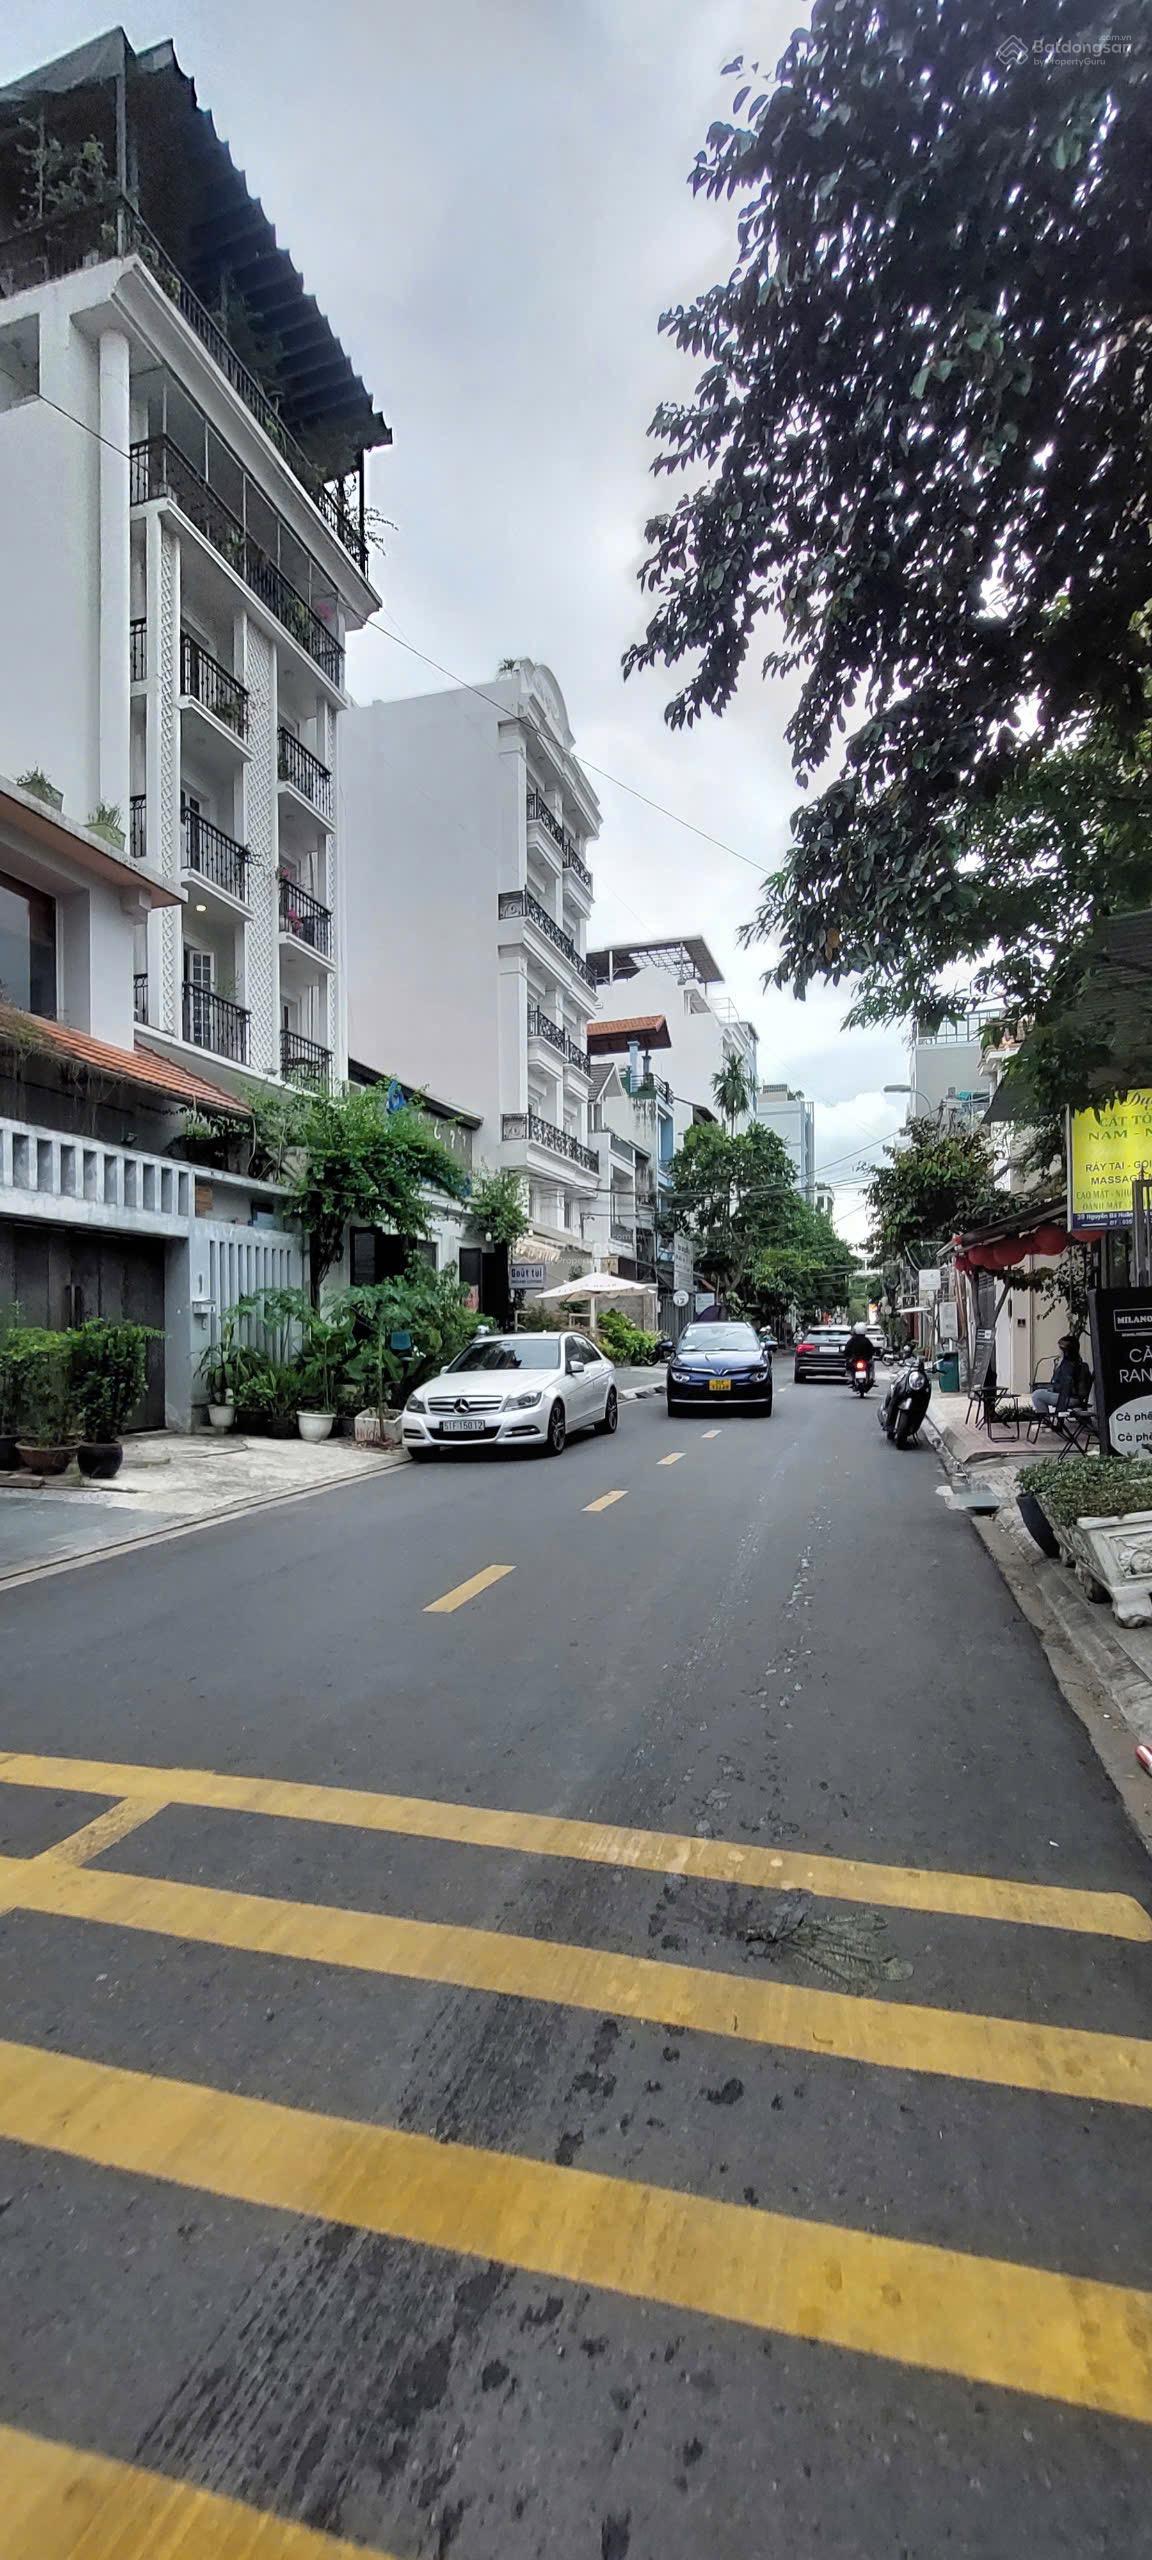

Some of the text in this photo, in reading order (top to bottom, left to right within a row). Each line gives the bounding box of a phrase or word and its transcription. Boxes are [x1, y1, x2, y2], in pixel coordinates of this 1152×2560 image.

[1088, 1130, 1128, 1141] NAM
[1116, 1412, 1131, 1421] Cà
[1117, 1432, 1133, 1441] Cà
